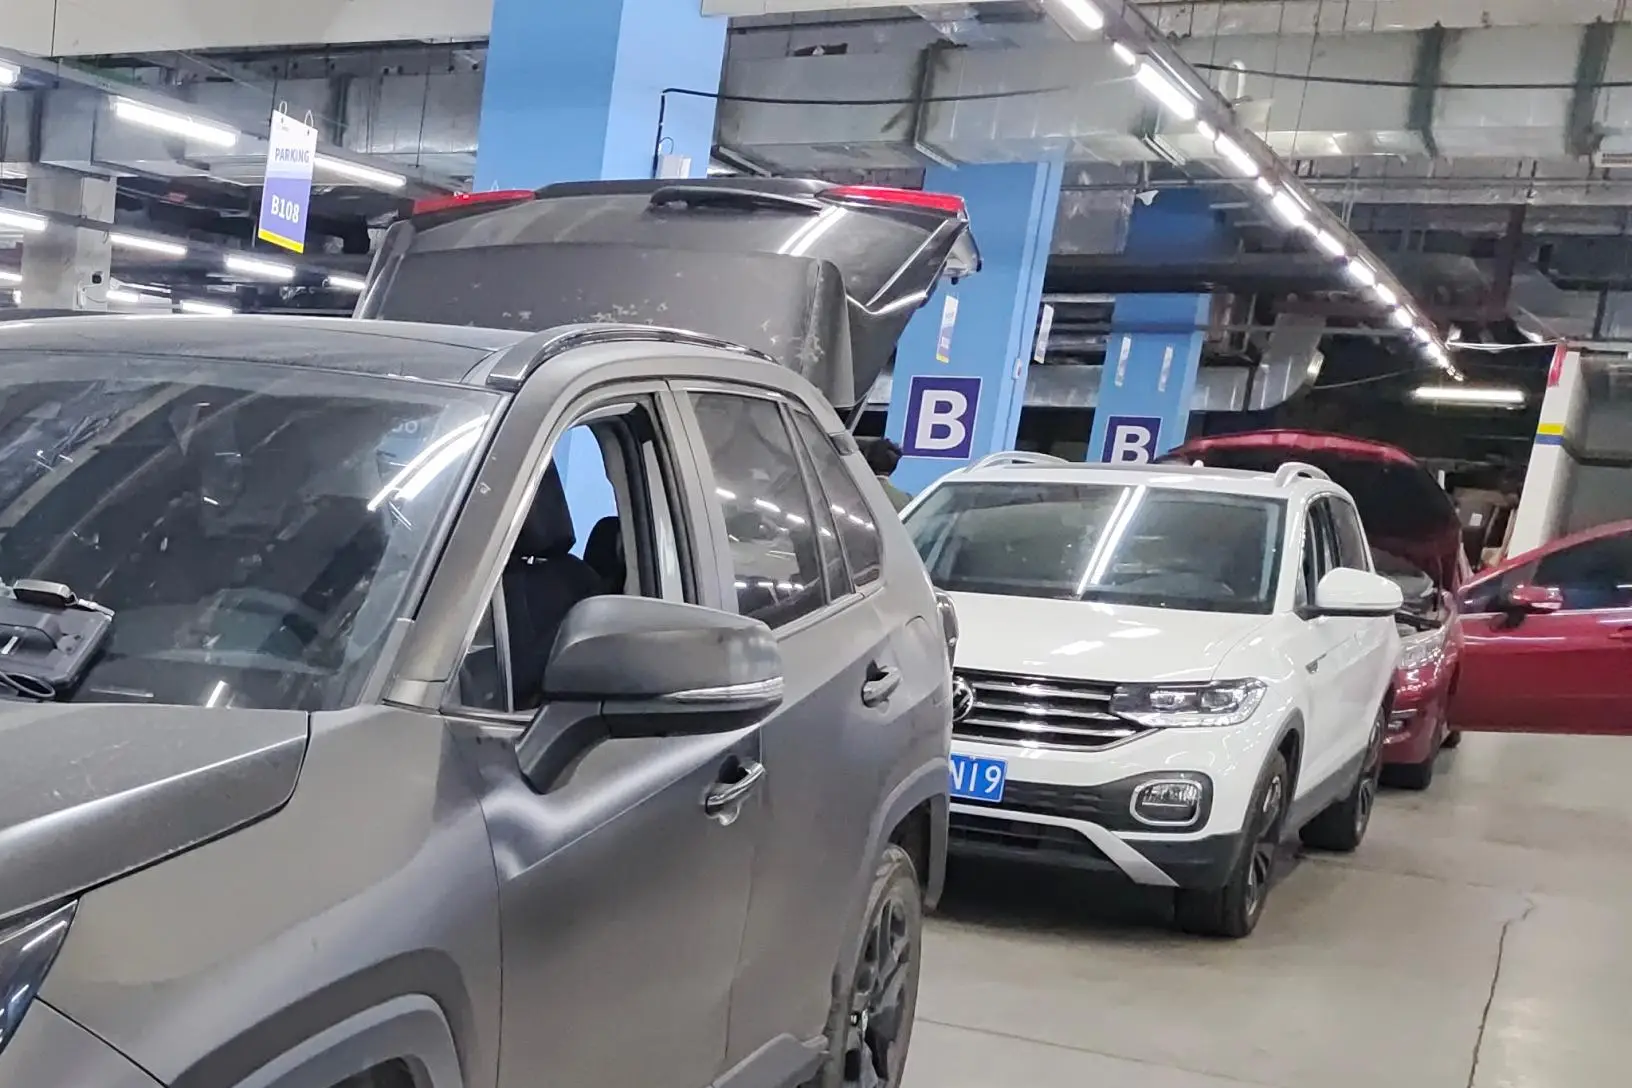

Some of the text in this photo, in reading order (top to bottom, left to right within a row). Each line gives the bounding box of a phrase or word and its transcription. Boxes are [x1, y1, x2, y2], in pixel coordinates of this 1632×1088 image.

[274, 147, 310, 164] PARKING
[270, 194, 300, 224] B108
[914, 389, 968, 450] B
[1110, 425, 1151, 464] B
